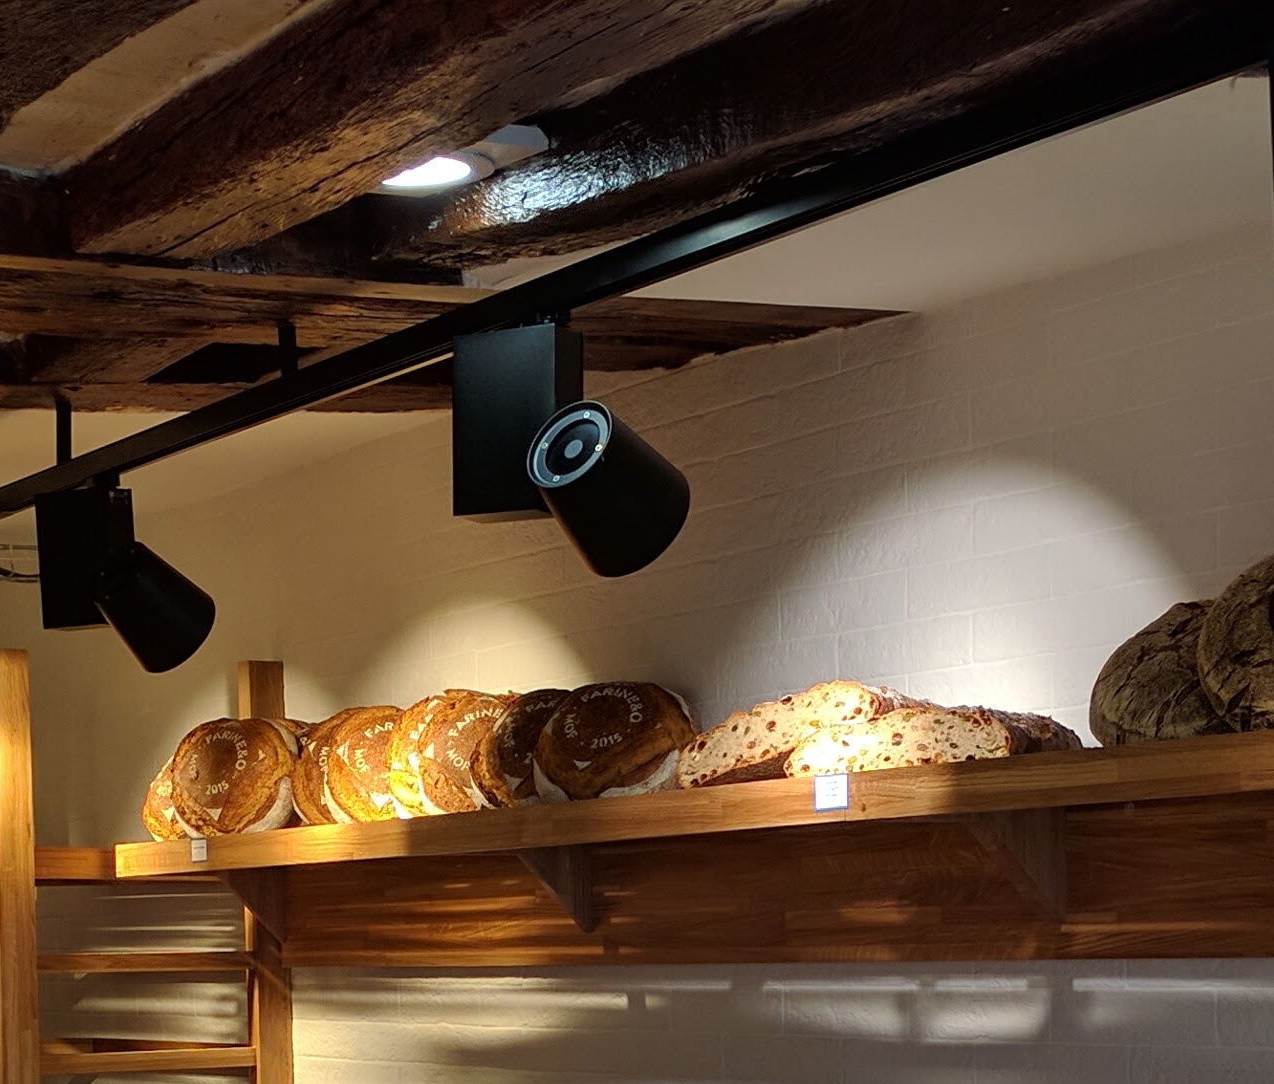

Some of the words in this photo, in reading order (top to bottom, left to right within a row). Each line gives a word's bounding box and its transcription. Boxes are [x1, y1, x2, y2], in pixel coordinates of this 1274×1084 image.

[447, 708, 504, 737] FARINE
[591, 732, 623, 749] 2015
[354, 748, 370, 773] MOF
[205, 780, 229, 795] 2015
